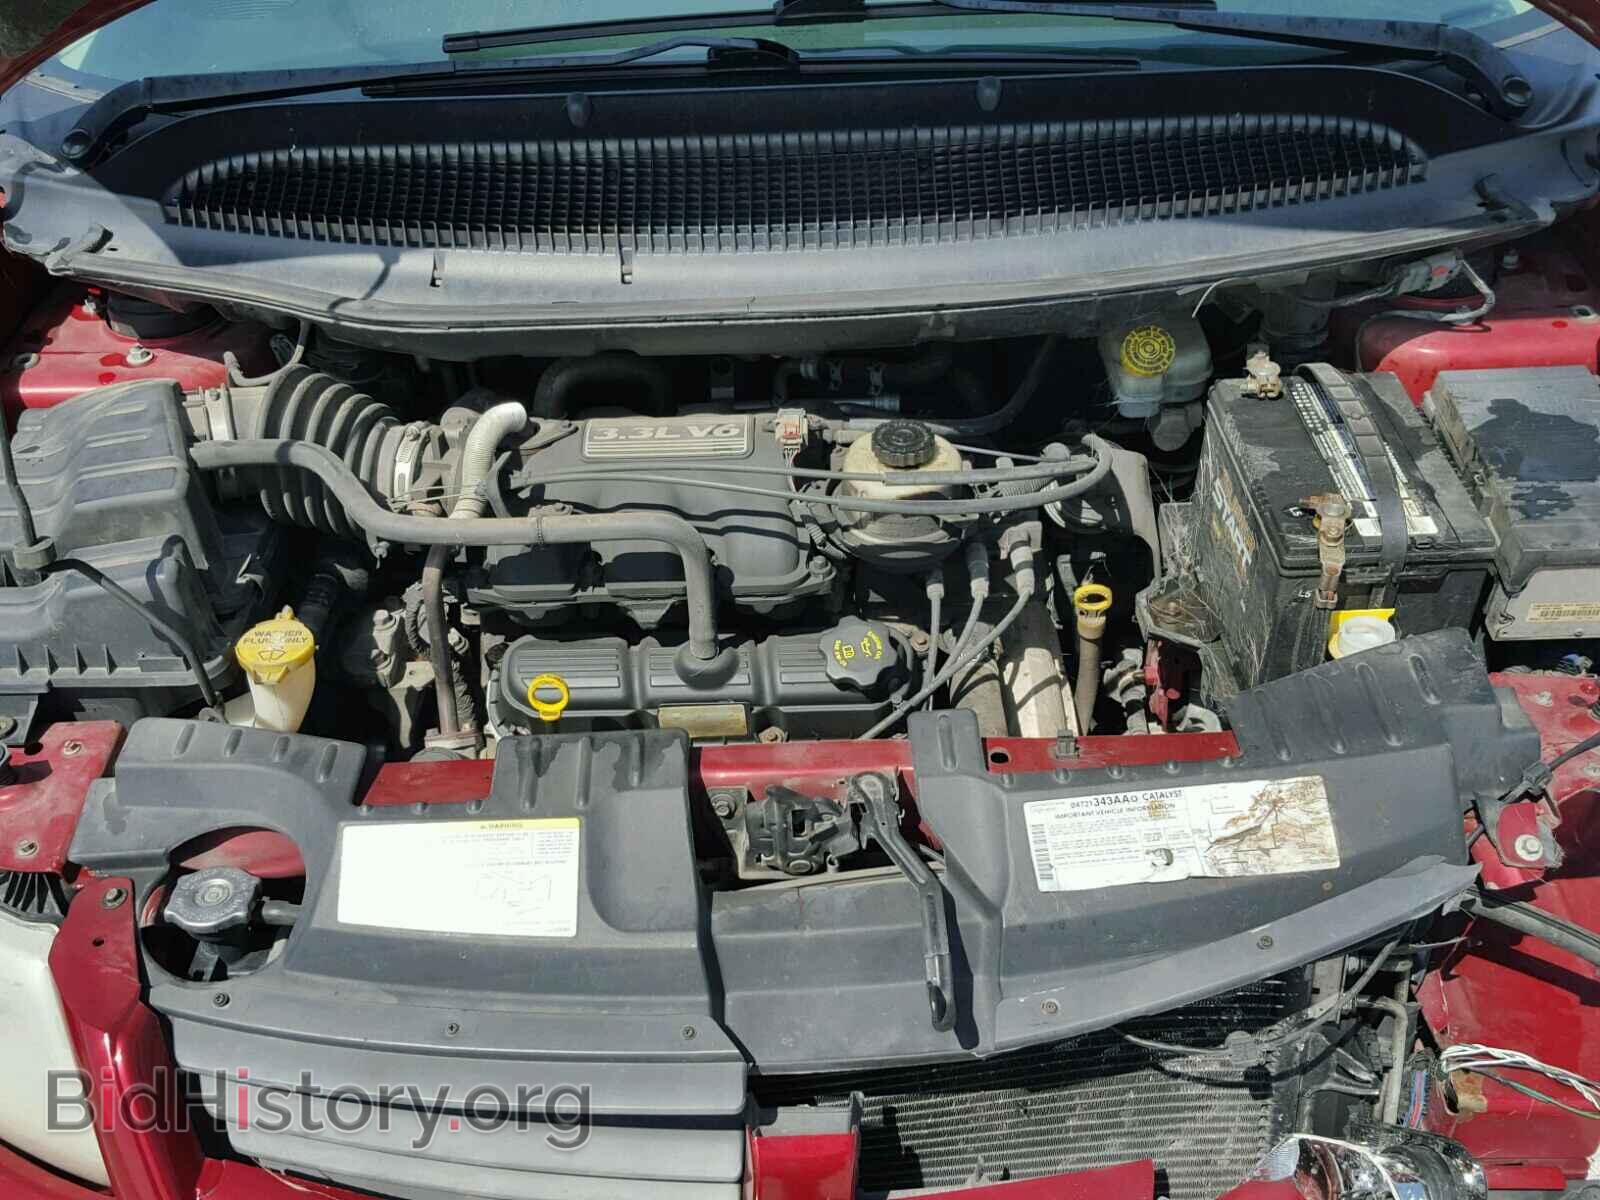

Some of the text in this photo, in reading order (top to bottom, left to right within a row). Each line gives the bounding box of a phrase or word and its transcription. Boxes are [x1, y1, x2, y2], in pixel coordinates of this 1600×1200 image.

[594, 424, 740, 440] 3.3L V6
[254, 630, 304, 638] WAER
[243, 636, 308, 645] FLU NLY
[1142, 789, 1184, 801] CATALYST
[1055, 803, 1176, 819] IMPORTANT VEHICLE INFORMATION
